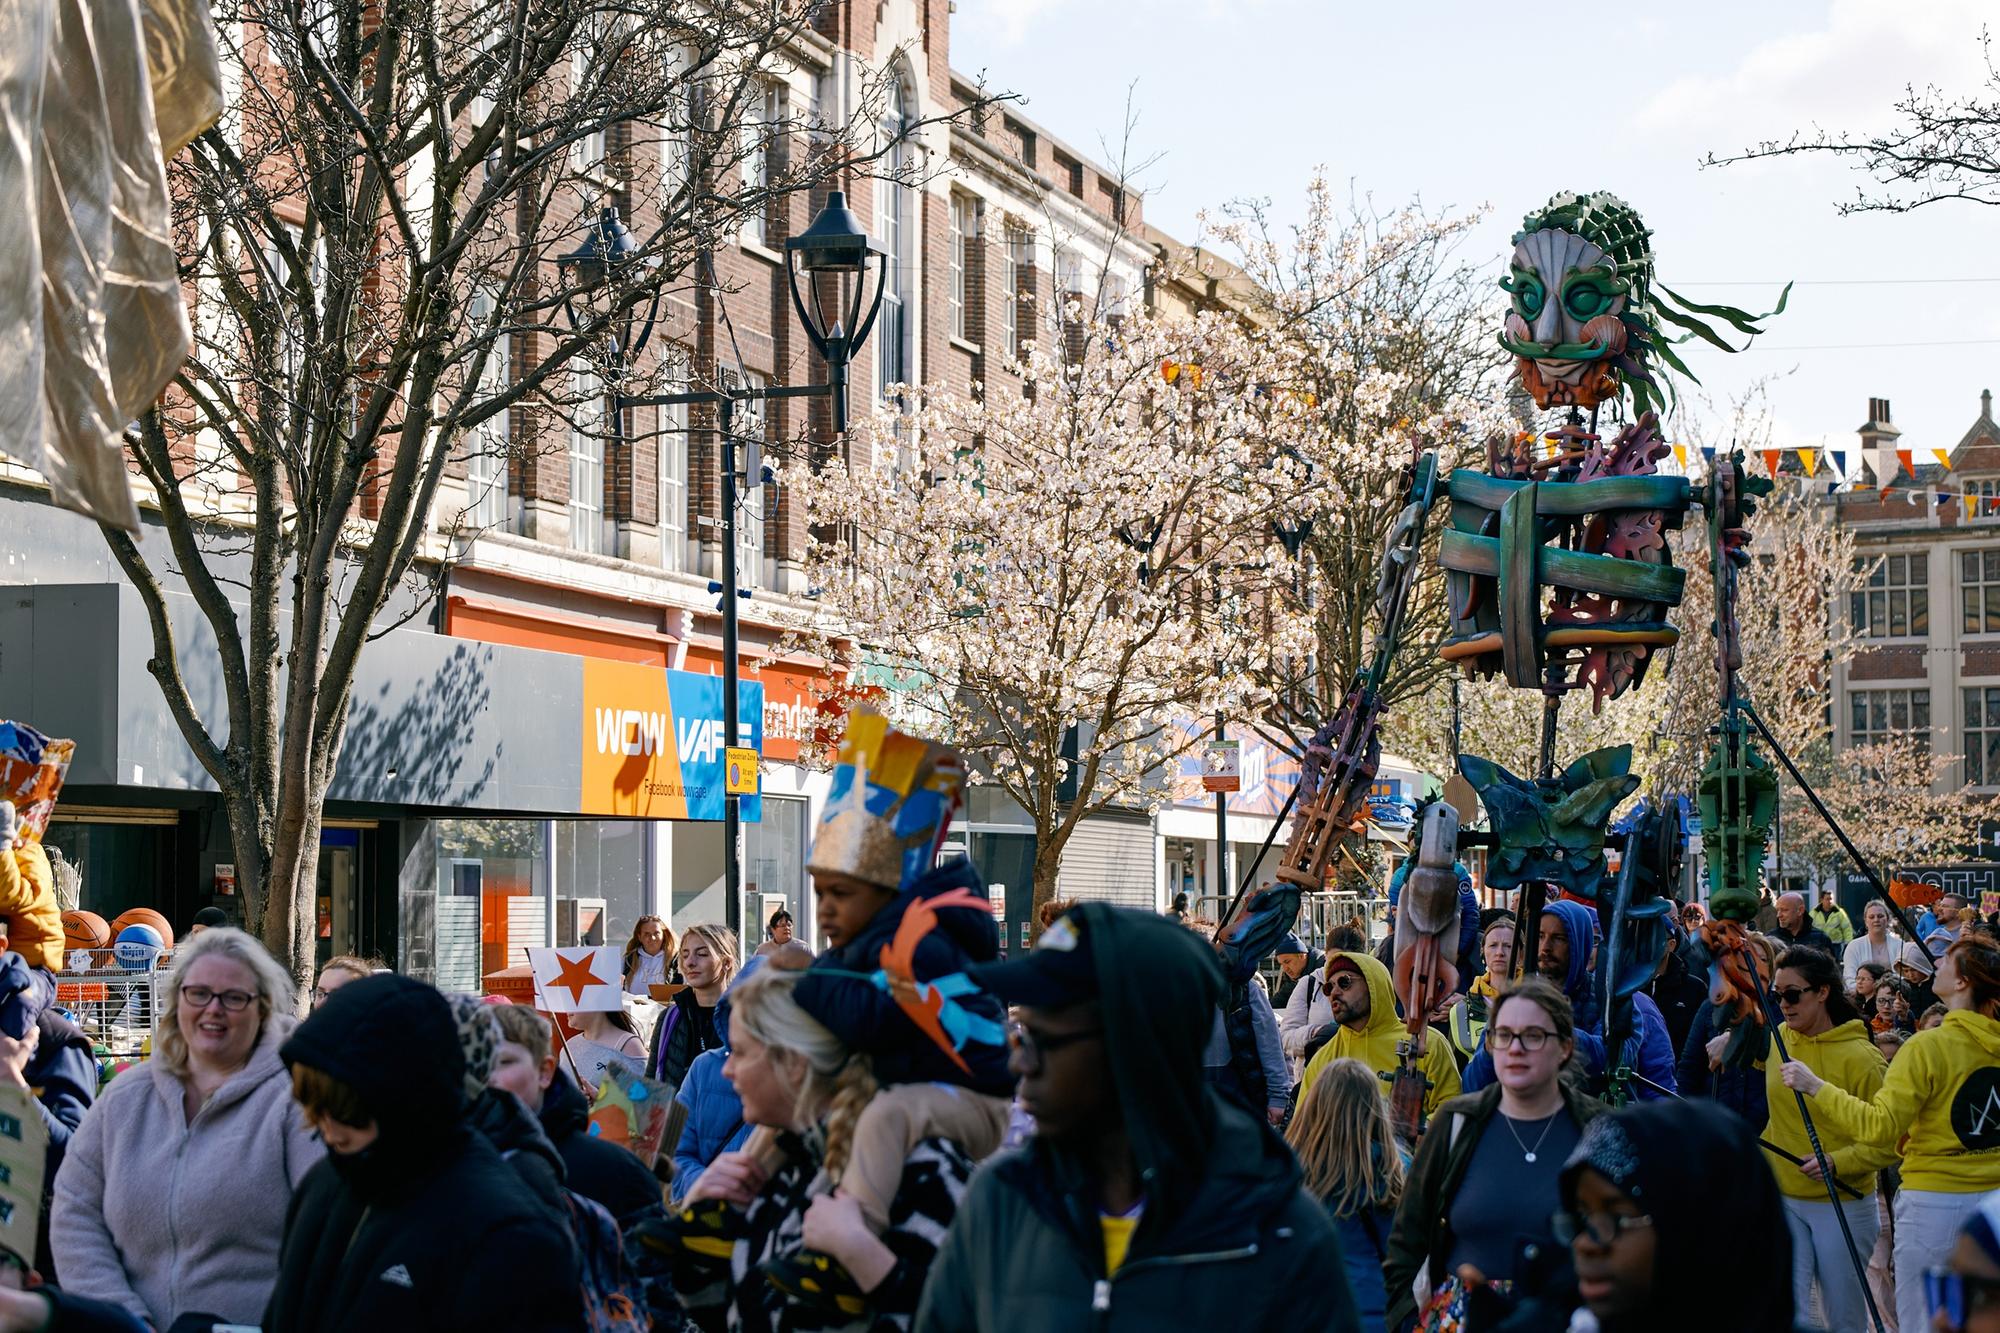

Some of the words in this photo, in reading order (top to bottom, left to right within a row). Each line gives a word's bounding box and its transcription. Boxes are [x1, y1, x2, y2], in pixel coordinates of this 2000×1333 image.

[596, 707, 666, 758] WOW
[747, 753, 756, 761] Zone
[644, 778, 675, 796] Facebook
